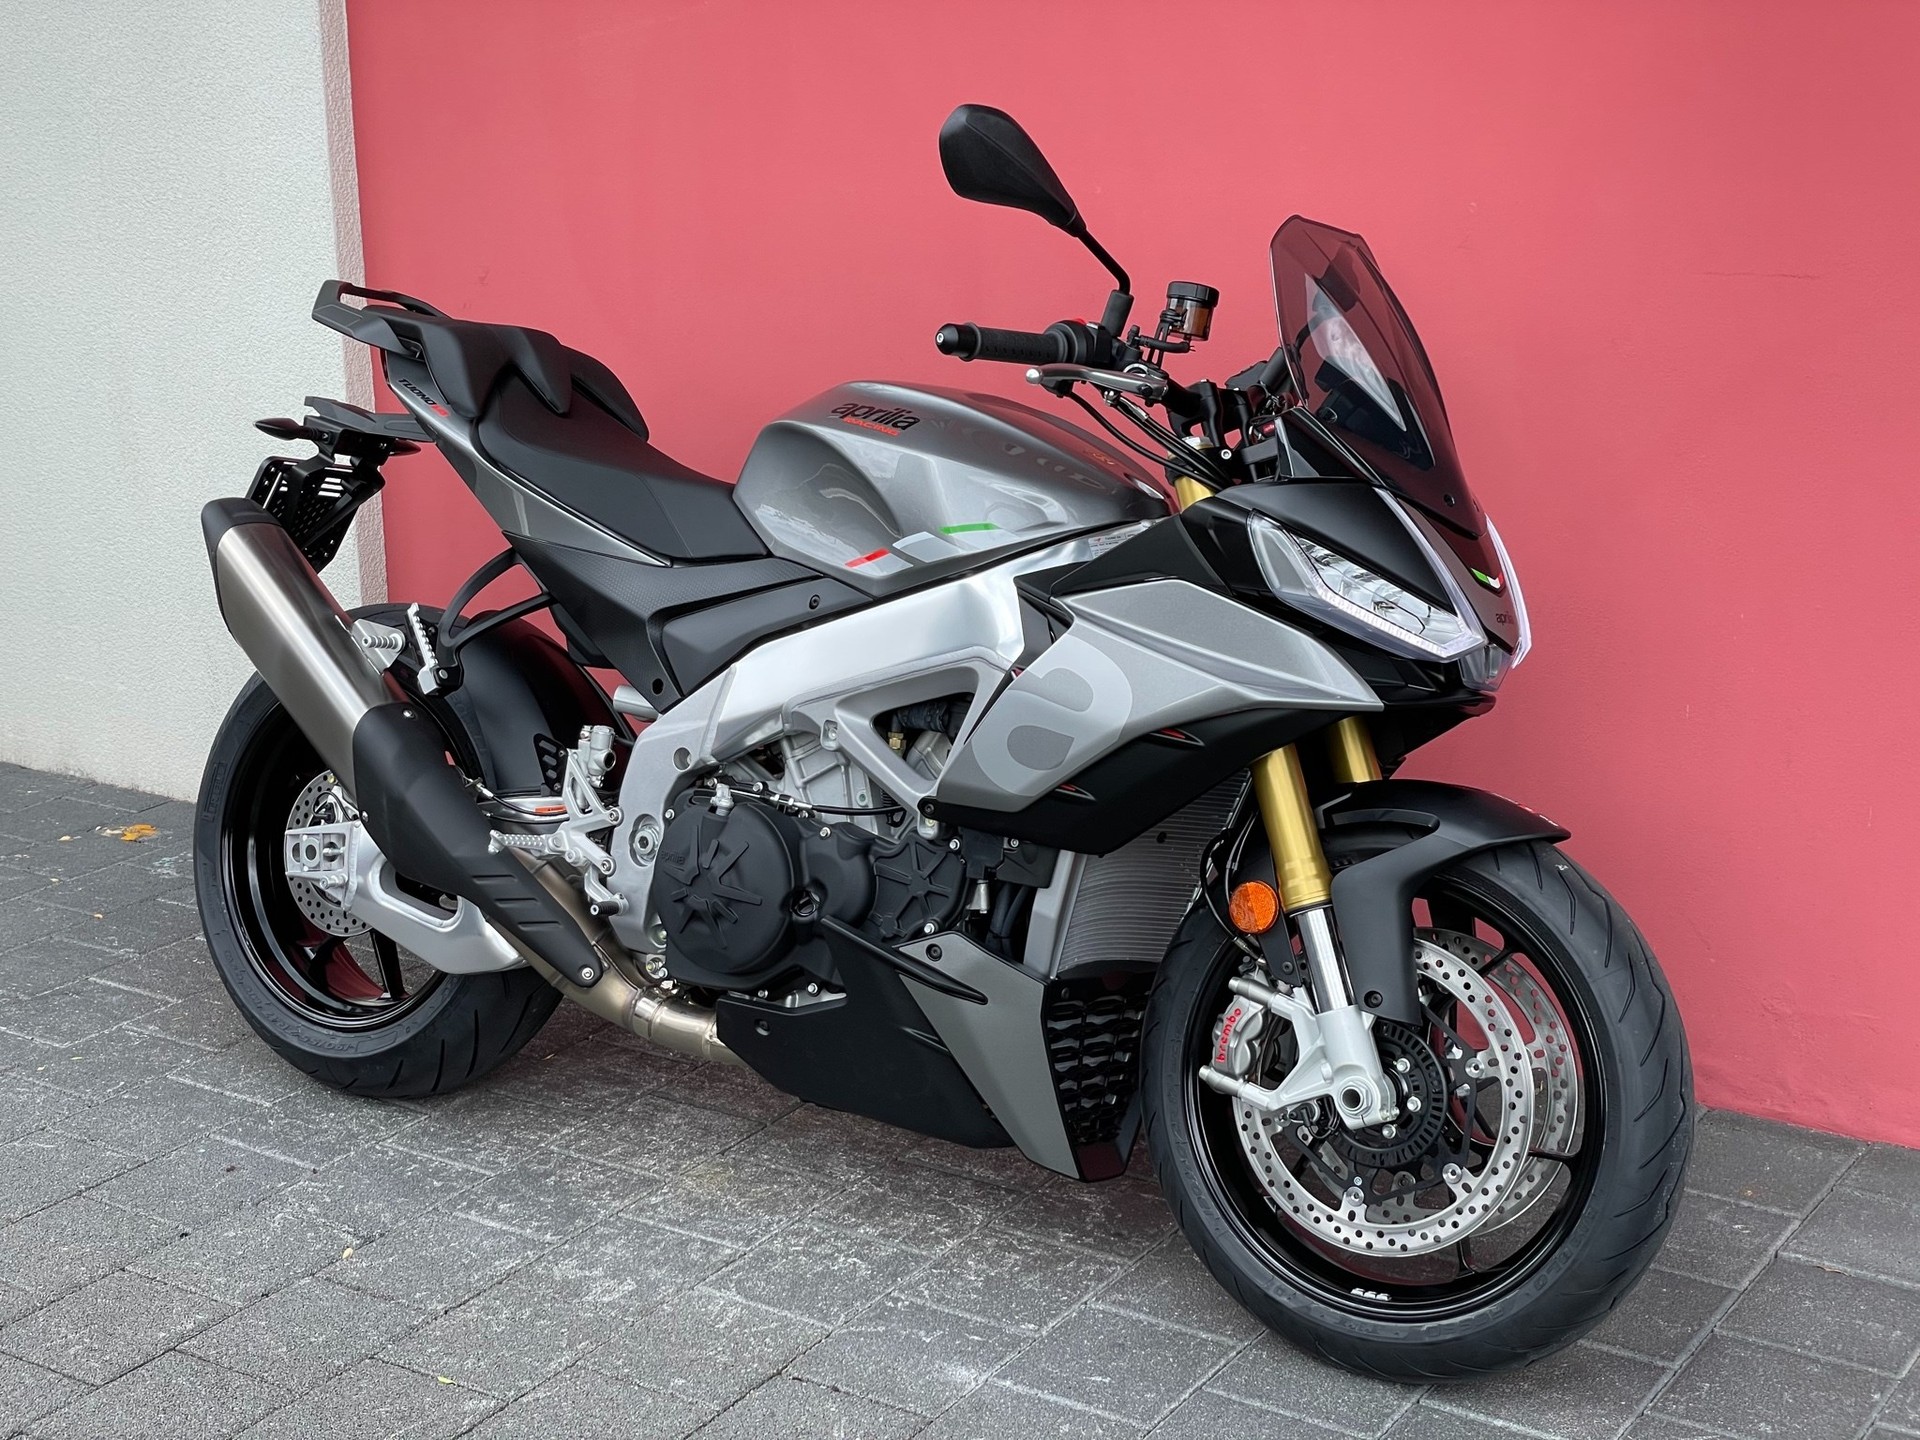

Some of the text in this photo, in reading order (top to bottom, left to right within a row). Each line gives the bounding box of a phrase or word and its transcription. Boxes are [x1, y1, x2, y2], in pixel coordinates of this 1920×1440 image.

[398, 378, 437, 405] TUONO
[831, 403, 921, 431] aprilia
[843, 416, 901, 436] RACING
[1216, 1008, 1242, 1062] brembo
